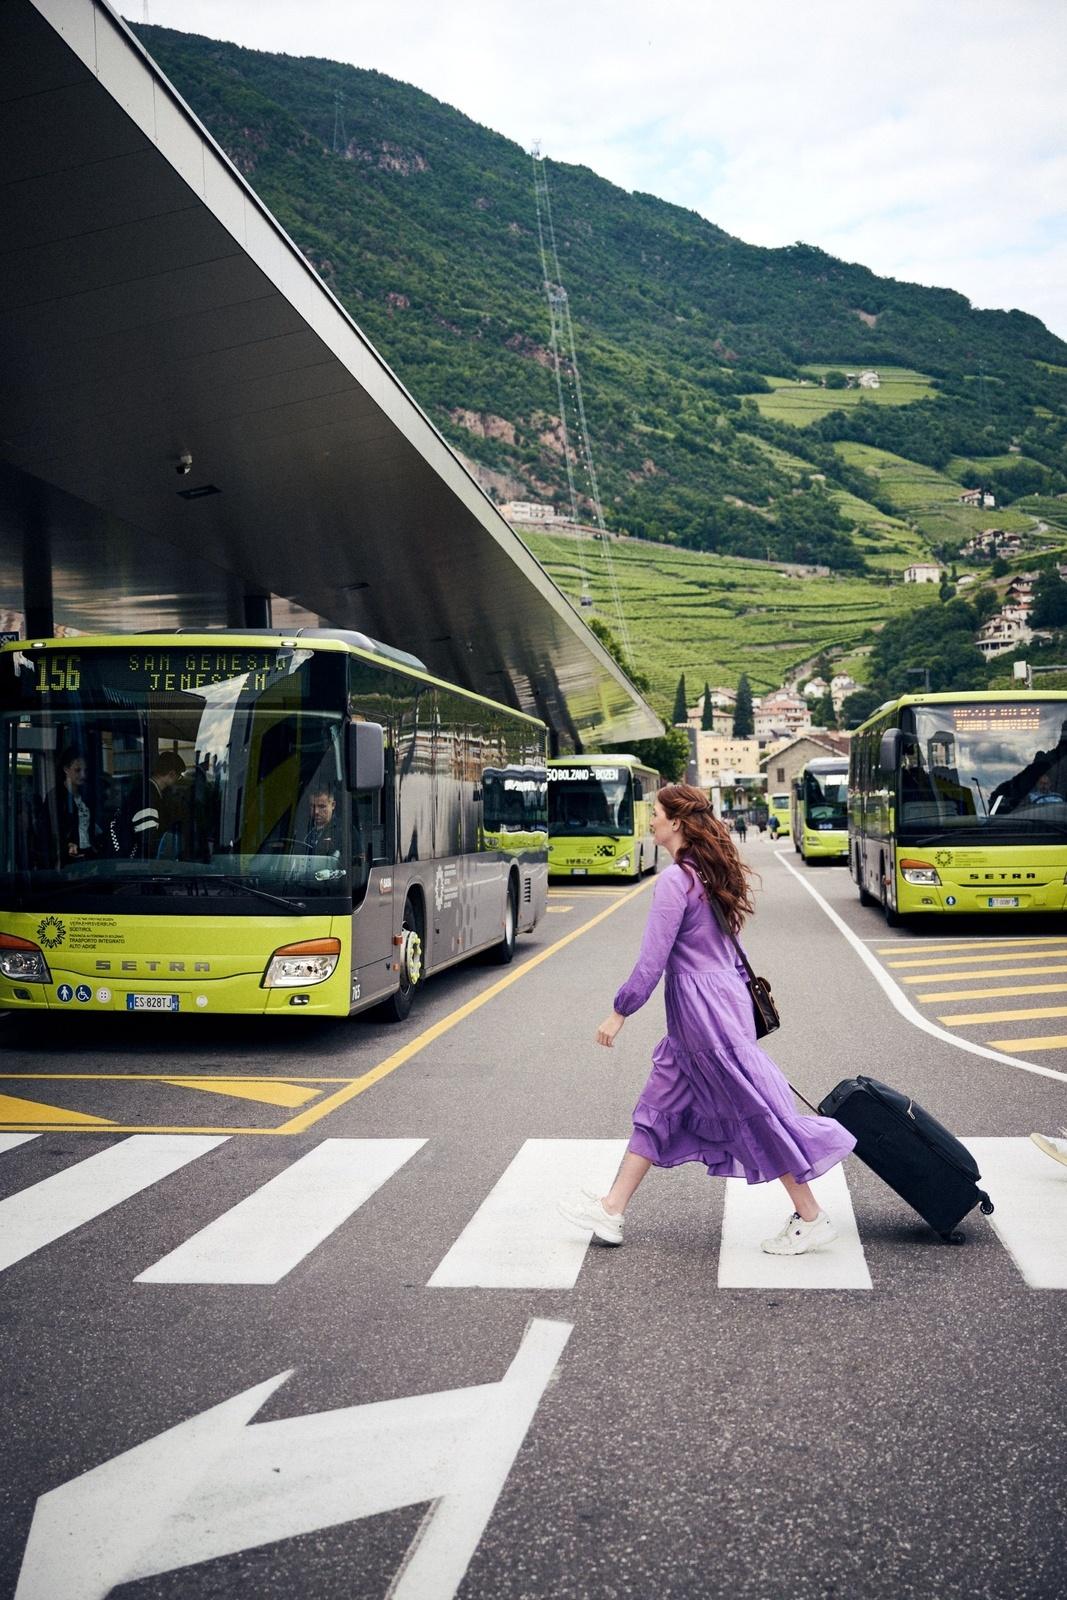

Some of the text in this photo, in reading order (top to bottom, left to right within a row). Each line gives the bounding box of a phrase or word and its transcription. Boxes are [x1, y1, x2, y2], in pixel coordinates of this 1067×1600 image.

[128, 654, 171, 671] SAN
[35, 656, 81, 691] 156
[149, 674, 267, 691] JENESN
[558, 768, 589, 781] BOLZANO
[969, 872, 1036, 880] SETRA
[95, 960, 211, 972] SETRA
